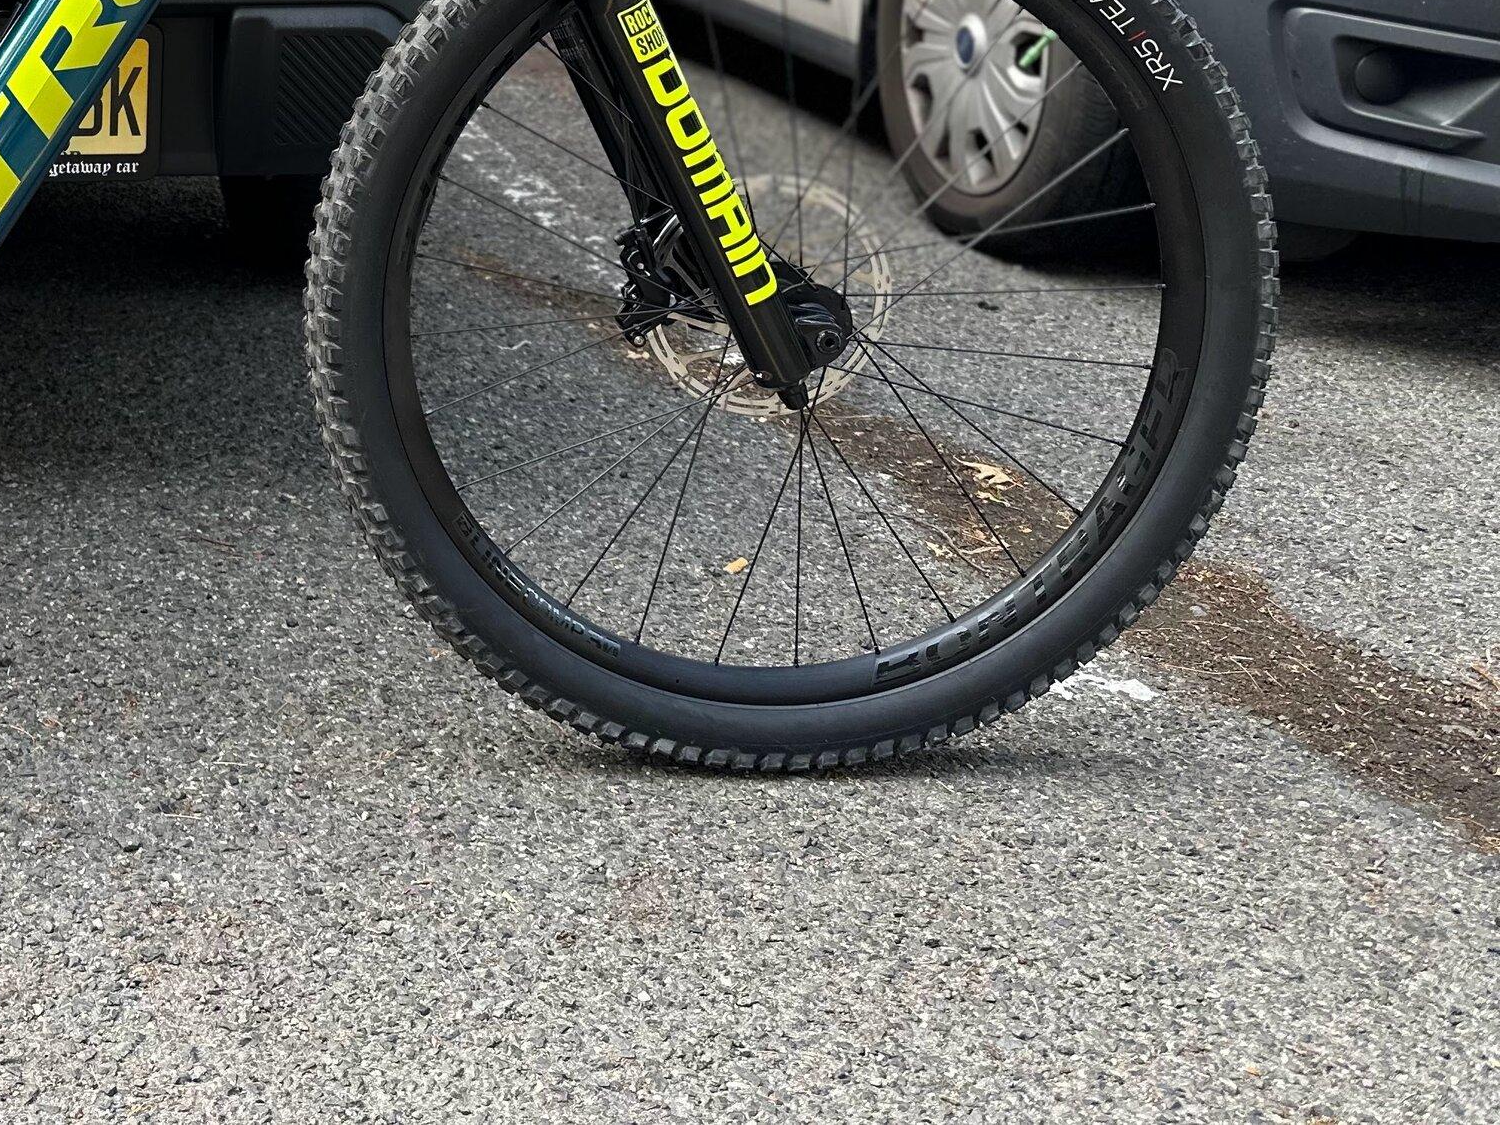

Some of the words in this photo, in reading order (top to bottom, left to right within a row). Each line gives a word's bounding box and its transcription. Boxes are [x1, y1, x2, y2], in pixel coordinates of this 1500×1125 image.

[1132, 38, 1184, 92] XR5
[48, 160, 112, 177] getaway
[116, 161, 140, 174] car
